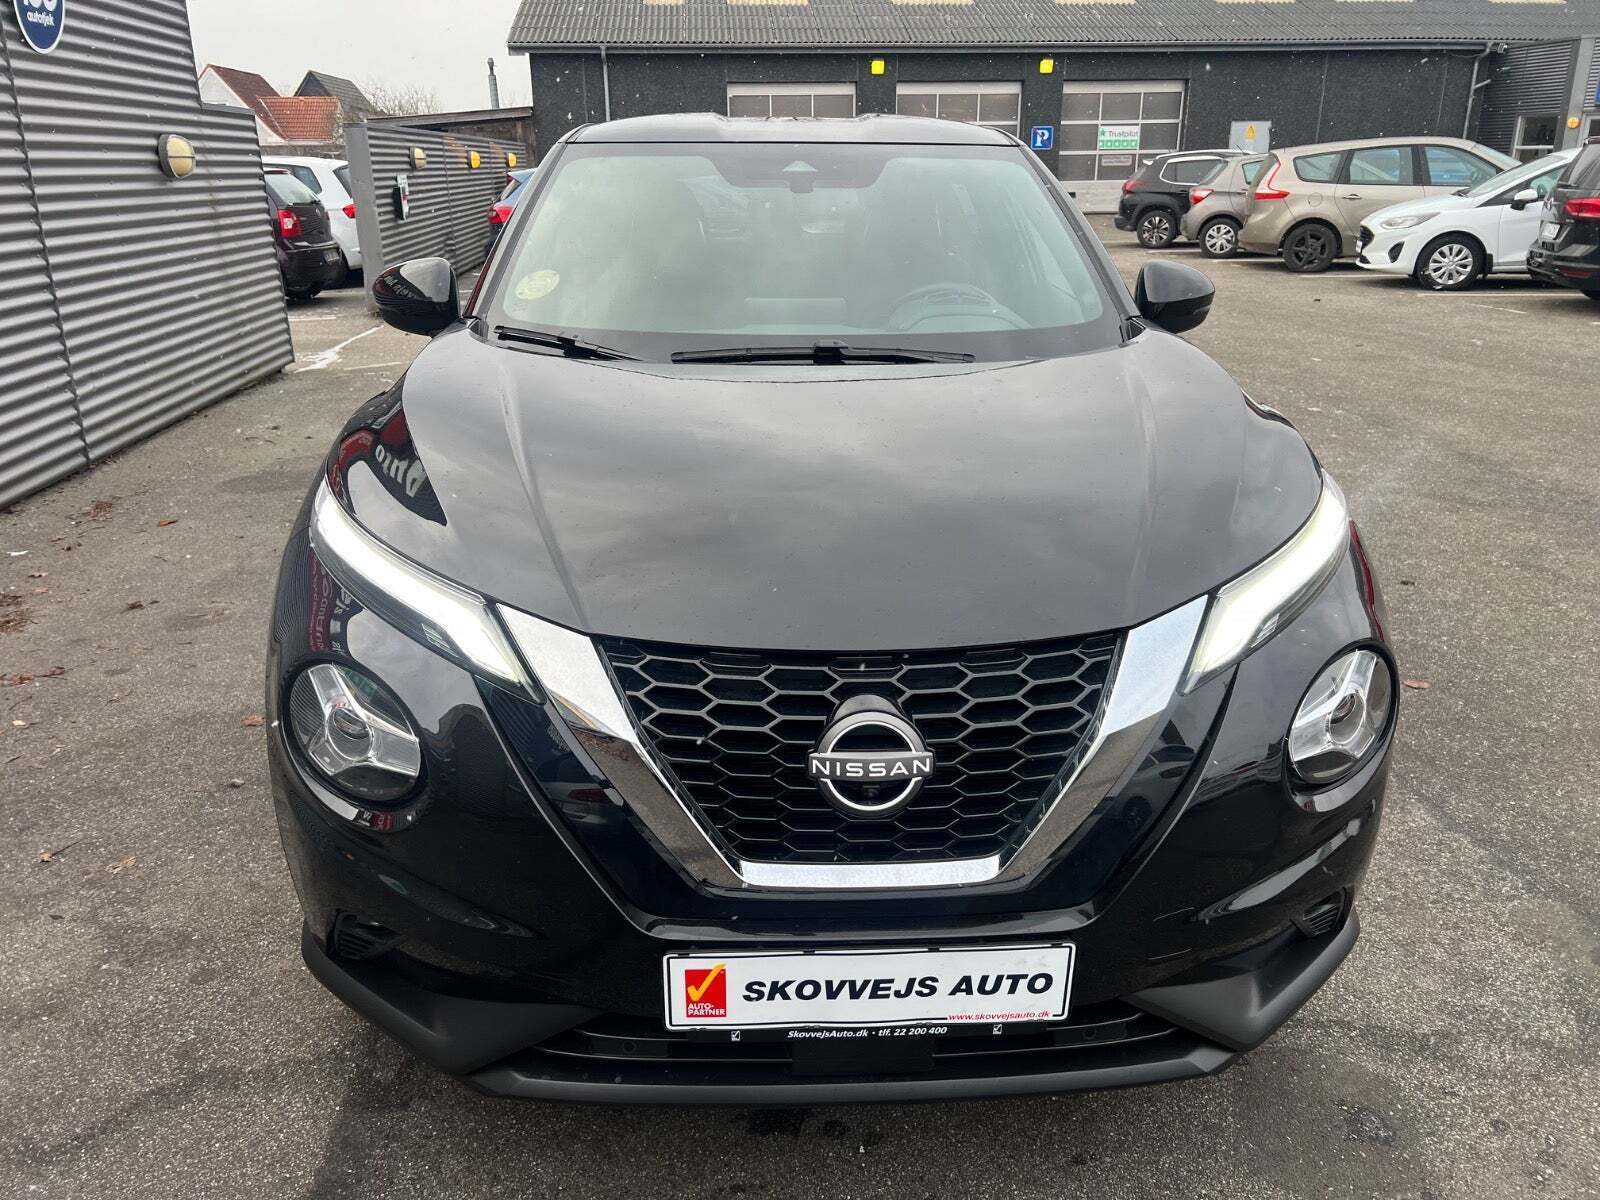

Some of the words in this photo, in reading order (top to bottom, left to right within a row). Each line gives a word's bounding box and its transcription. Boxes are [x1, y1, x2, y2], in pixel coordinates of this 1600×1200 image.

[27, 11, 55, 27] autotjek
[1035, 129, 1049, 147] P
[811, 758, 930, 777] NISSAN
[742, 976, 940, 1002] SKOVVEJS
[948, 973, 1054, 996] AUTO
[948, 1011, 1051, 1021] www.skovvejsauto.dk
[787, 1029, 869, 1039] SkovvejsAuto.dk
[878, 1028, 891, 1037] tlf.
[894, 1028, 907, 1036] 22
[908, 1027, 927, 1036] 200
[928, 1026, 948, 1035] 400
